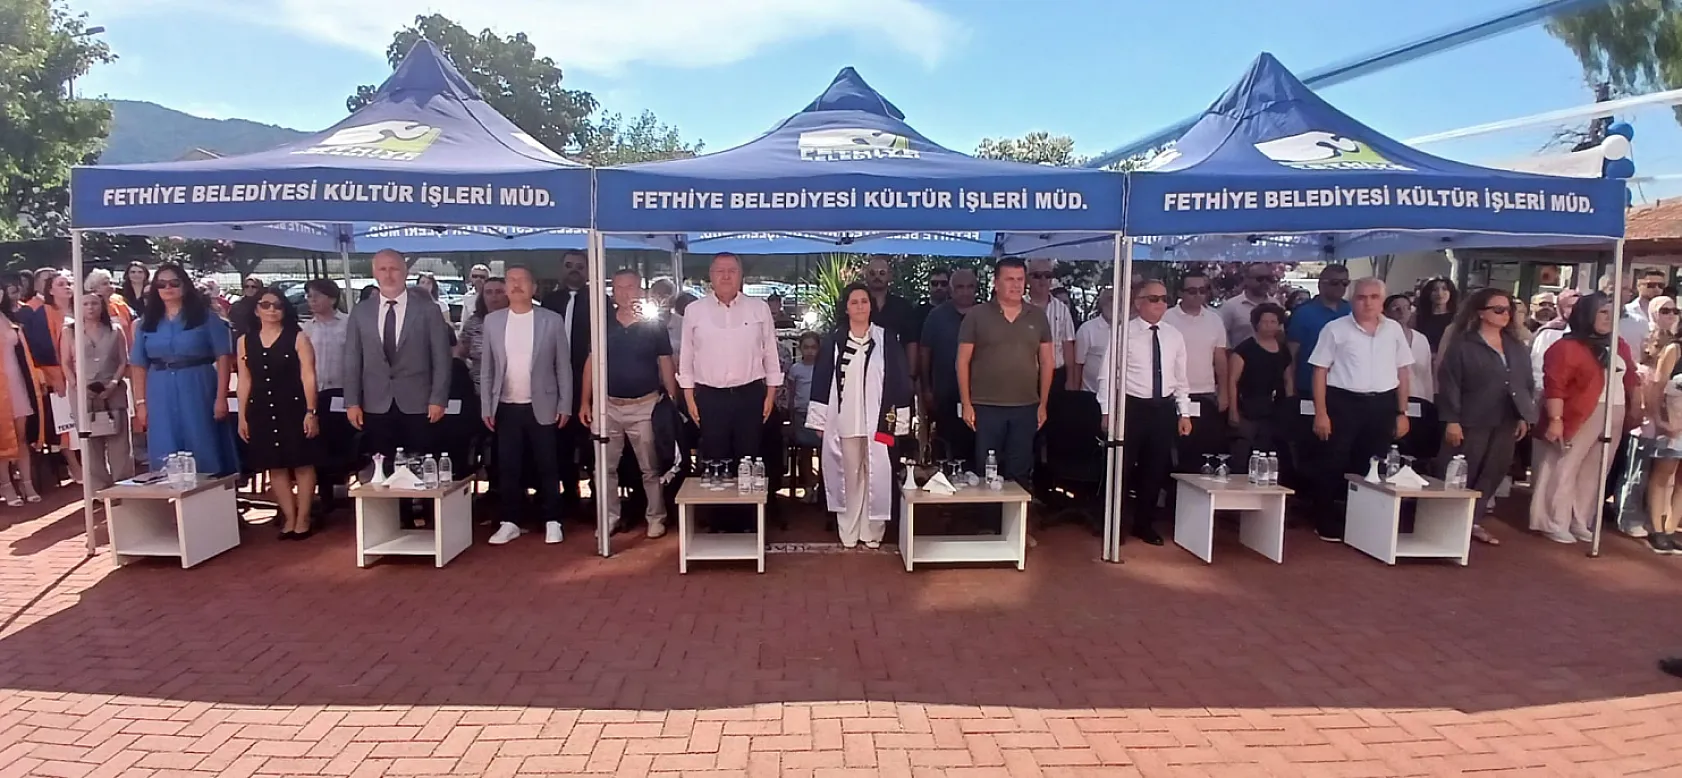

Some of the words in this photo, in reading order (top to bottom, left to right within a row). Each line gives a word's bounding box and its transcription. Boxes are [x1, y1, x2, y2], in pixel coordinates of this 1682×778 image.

[104, 184, 186, 206] FETHİYE
[192, 180, 317, 203] BELEDİYESİ
[324, 181, 413, 203] KÜLTÜR
[421, 182, 492, 208] İŞLERİ
[500, 185, 555, 207] MÜD.
[633, 189, 723, 209] FETHİYE
[730, 188, 856, 209] BELEDİYESİ
[865, 188, 951, 209] KÜLTÜR
[959, 188, 1027, 213] İŞLERİ
[1036, 189, 1087, 210] MÜD.
[1165, 188, 1257, 211] FETHİYE
[1265, 185, 1389, 208] BELEDİYESİ
[1397, 186, 1479, 208] KÜLTÜR
[1485, 188, 1545, 213] İŞLERİ
[1551, 192, 1594, 214] MÜD.
